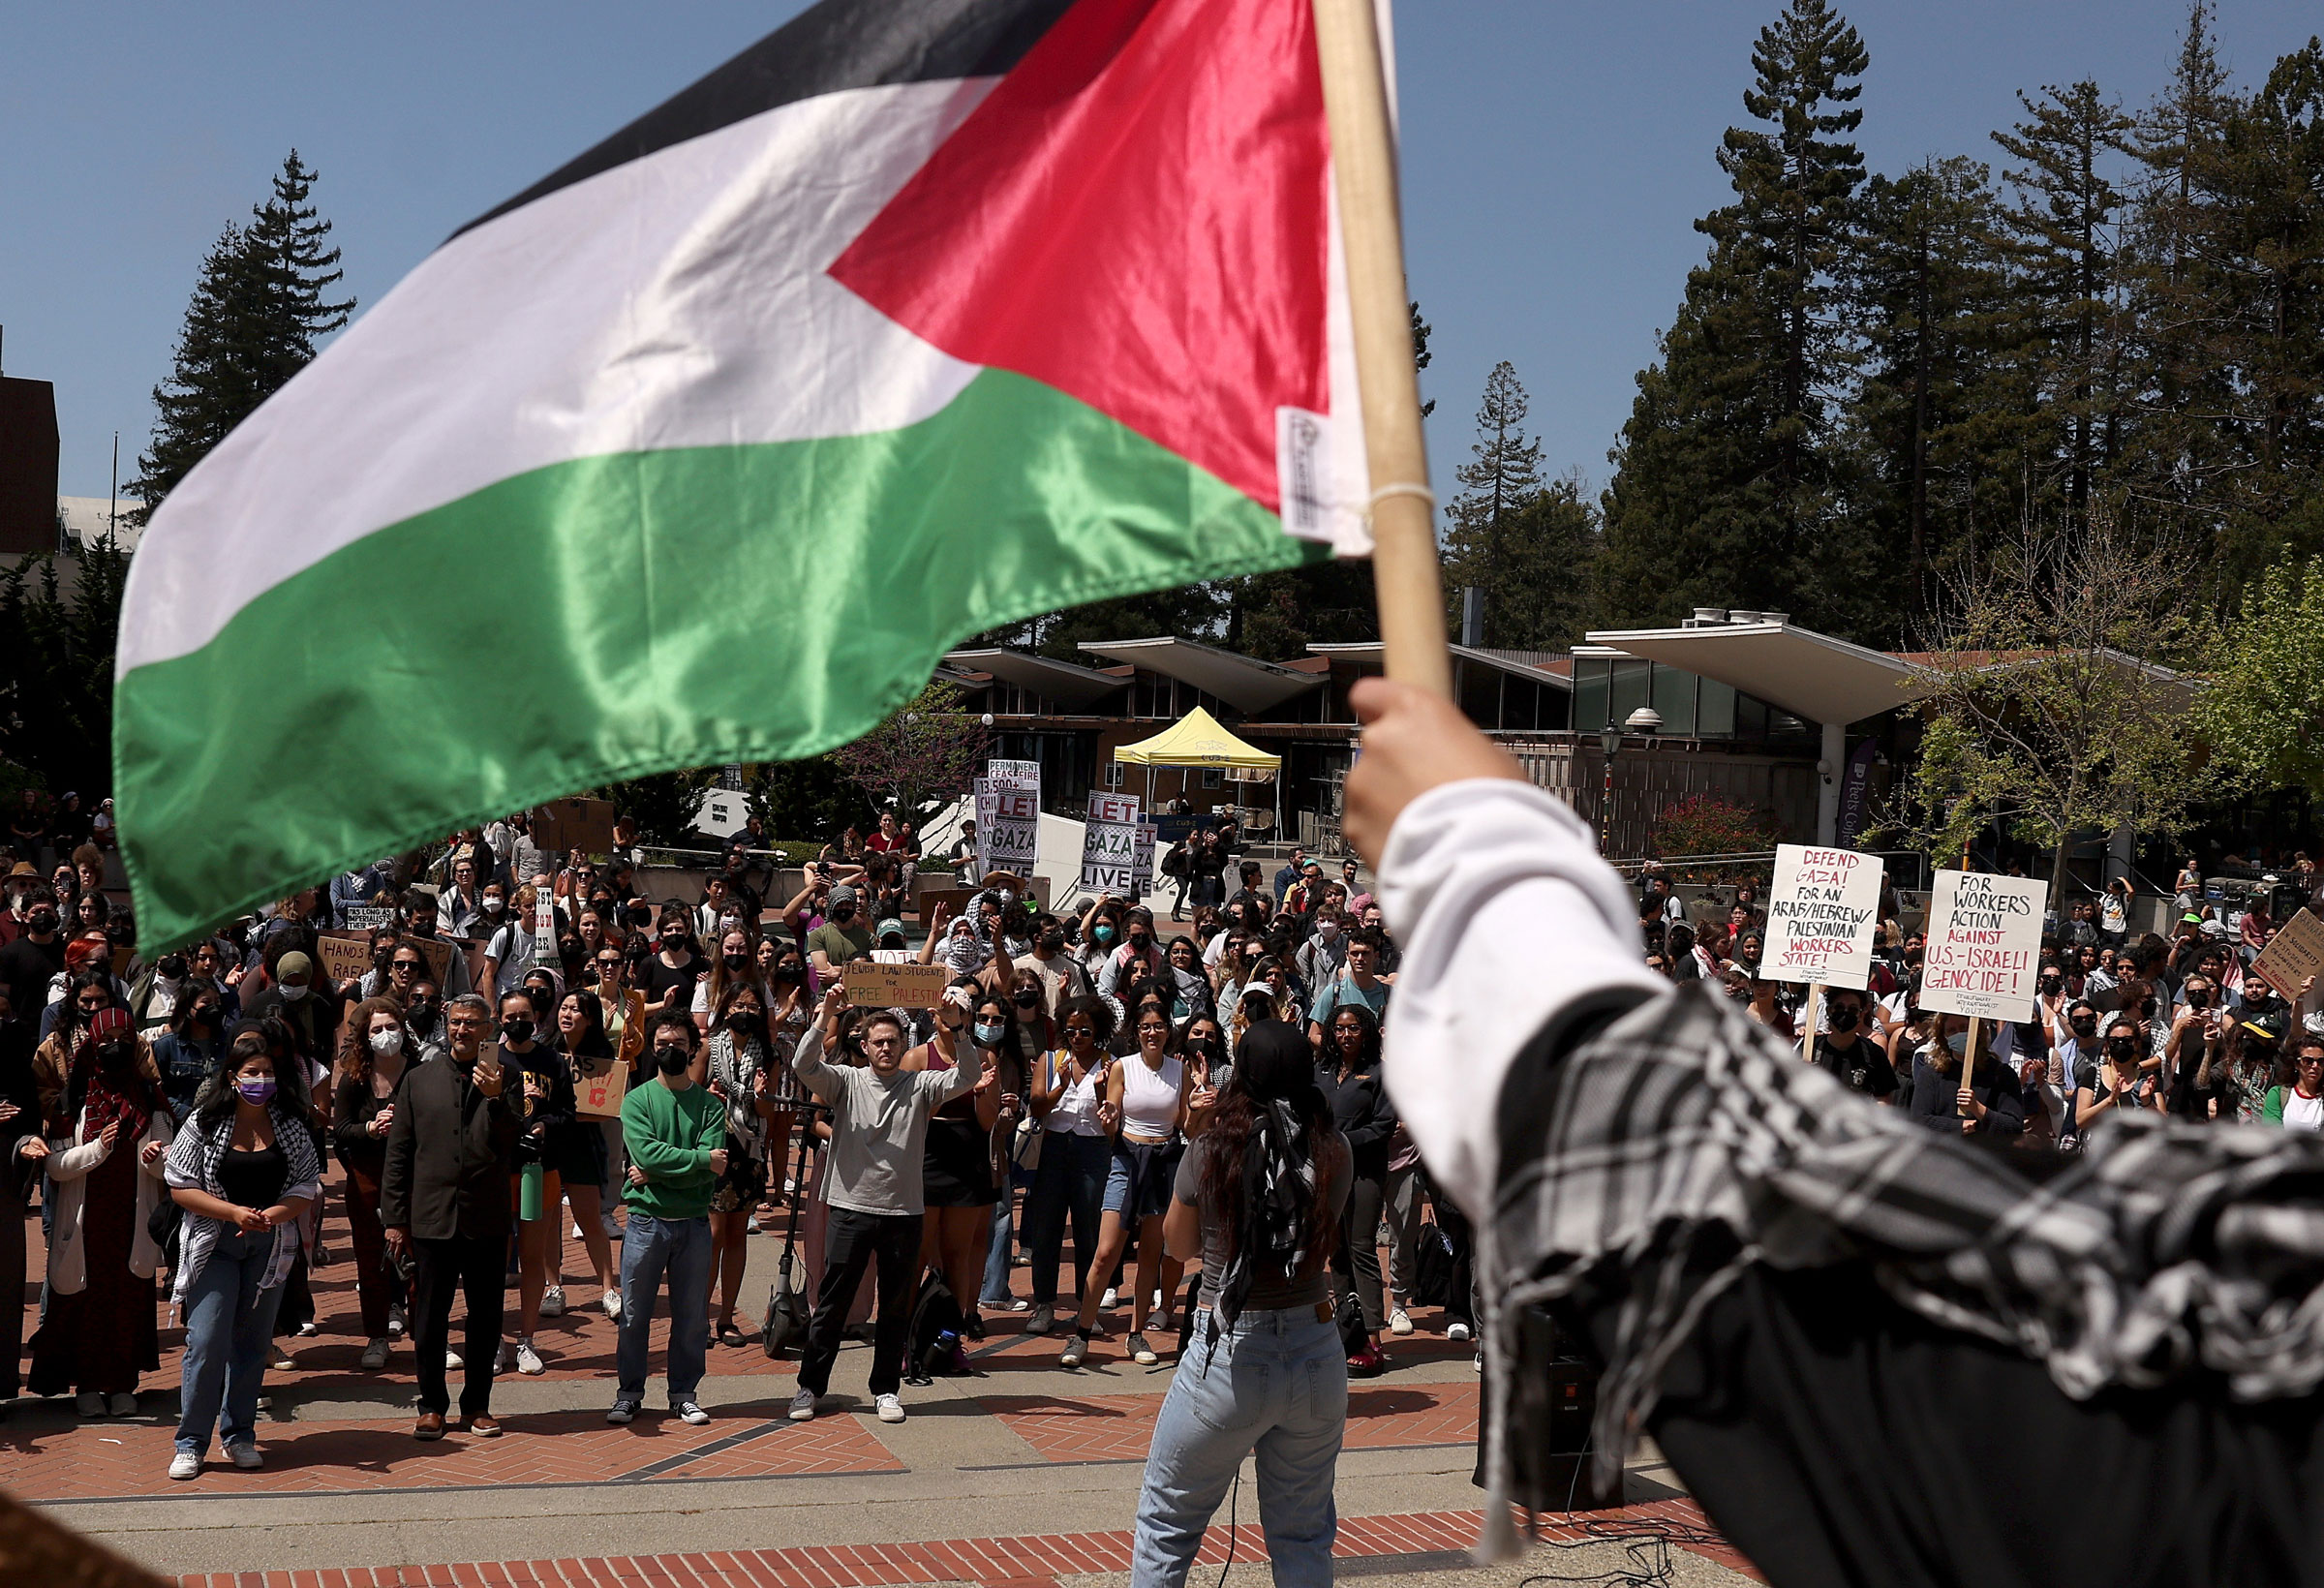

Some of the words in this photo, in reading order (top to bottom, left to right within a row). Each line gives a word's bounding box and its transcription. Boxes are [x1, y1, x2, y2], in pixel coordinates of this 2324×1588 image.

[990, 761, 1038, 772] PERMANENT
[999, 796, 1037, 816] LET
[1089, 799, 1137, 822] LET
[992, 827, 1035, 850] GAZA
[1085, 833, 1132, 855] GAZA
[1135, 830, 1155, 843] ET
[1133, 853, 1152, 868] ZA
[1803, 850, 1859, 869] DEFEND
[1082, 866, 1131, 888] LIVE
[1796, 868, 1848, 889] GAZA!
[1960, 875, 1992, 892] FOR
[1797, 887, 1819, 901] FOR
[1822, 888, 1843, 901] AN
[1771, 901, 1873, 924] ARAB/HEBREW/
[1954, 891, 2031, 916] WORKERS
[1787, 920, 1857, 938] PALESTINIAN
[1949, 910, 2003, 930] ACTION
[1790, 937, 1853, 955] WORKERS
[1947, 929, 2006, 945] AGAINST
[324, 942, 364, 959] HANDS
[1927, 945, 2029, 971] U.S.-ISRAELI
[1779, 952, 1827, 968] STATE!
[844, 963, 875, 974] JEWISH
[882, 965, 902, 976] LAW
[904, 967, 946, 977] STUDENTS
[1925, 966, 2018, 994] GENOCIDE!
[849, 987, 882, 1001] FREE
[1960, 1007, 1990, 1016] YOUTH
